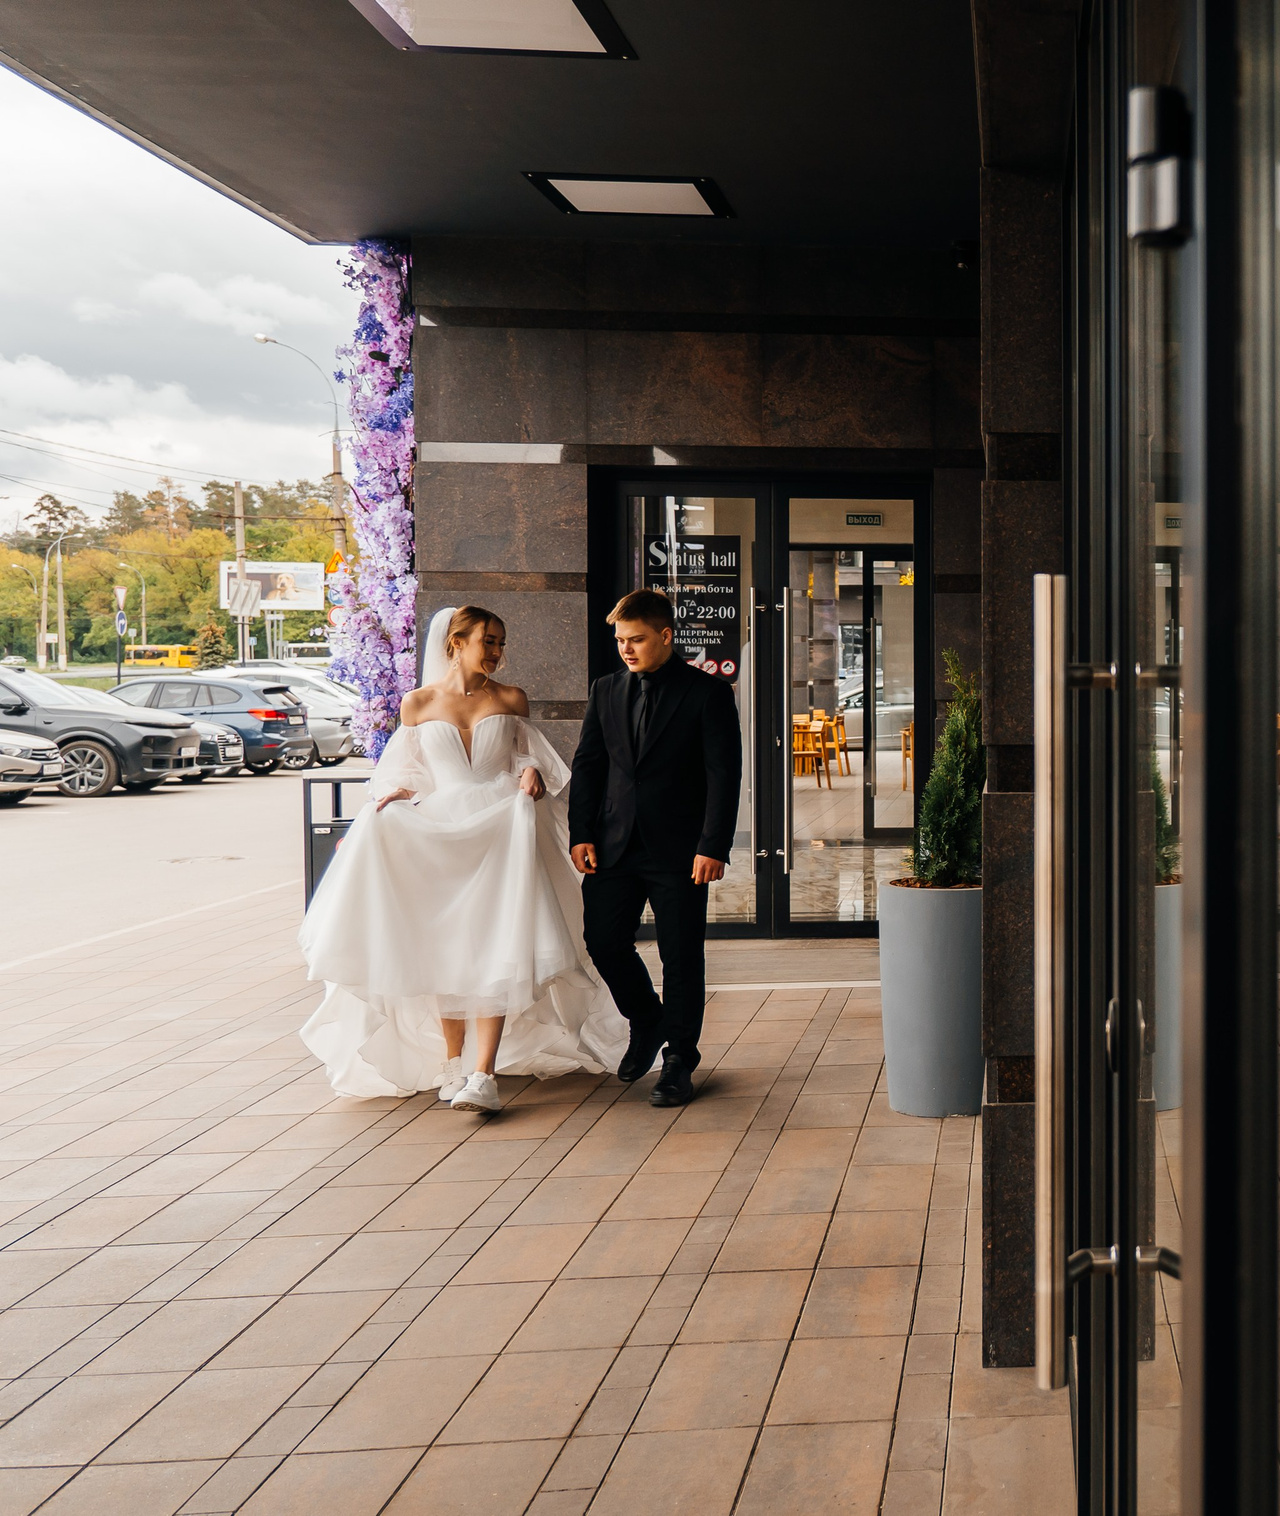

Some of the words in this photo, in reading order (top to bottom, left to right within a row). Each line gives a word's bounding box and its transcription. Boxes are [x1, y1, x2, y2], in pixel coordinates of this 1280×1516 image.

[848, 516, 880, 524] ВЫХОД
[711, 552, 736, 567] hall
[694, 583, 734, 595] работы
[697, 605, 736, 619] 22:00
[680, 629, 724, 637] ПЕРЕРЫВА
